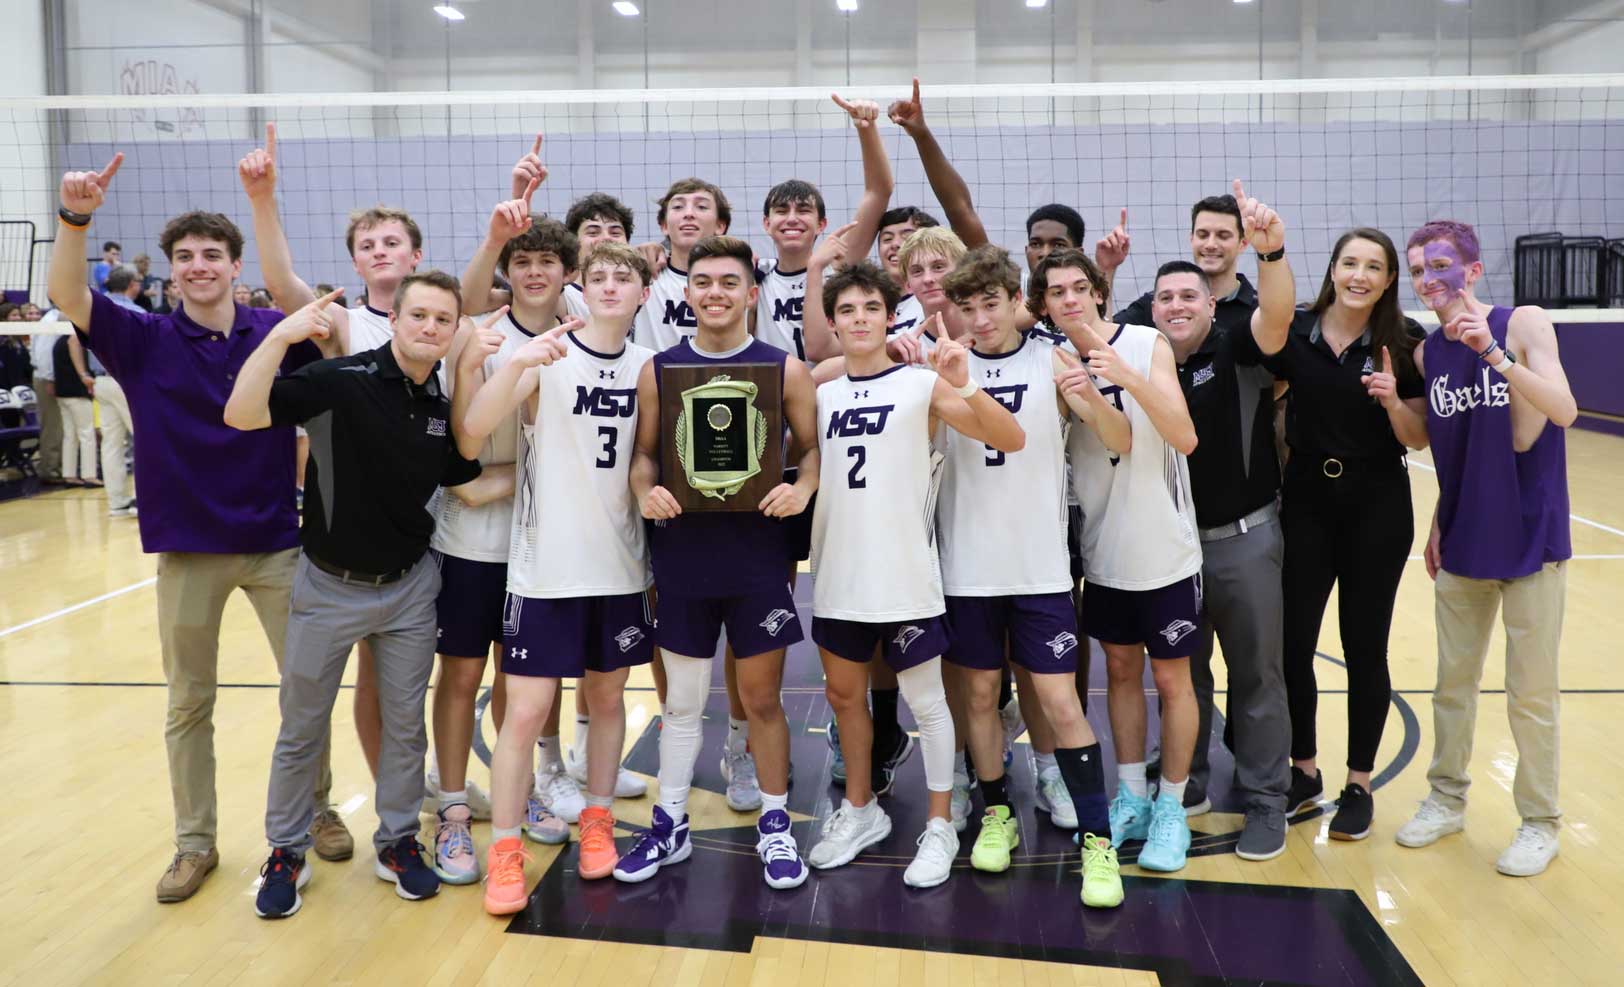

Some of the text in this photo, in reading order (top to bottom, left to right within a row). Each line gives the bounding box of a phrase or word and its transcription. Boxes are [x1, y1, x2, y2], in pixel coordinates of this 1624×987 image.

[773, 296, 805, 322] MS
[573, 385, 637, 418] MSJ
[826, 404, 896, 439] MSJ
[596, 426, 618, 469] 3
[847, 445, 867, 489] 2
